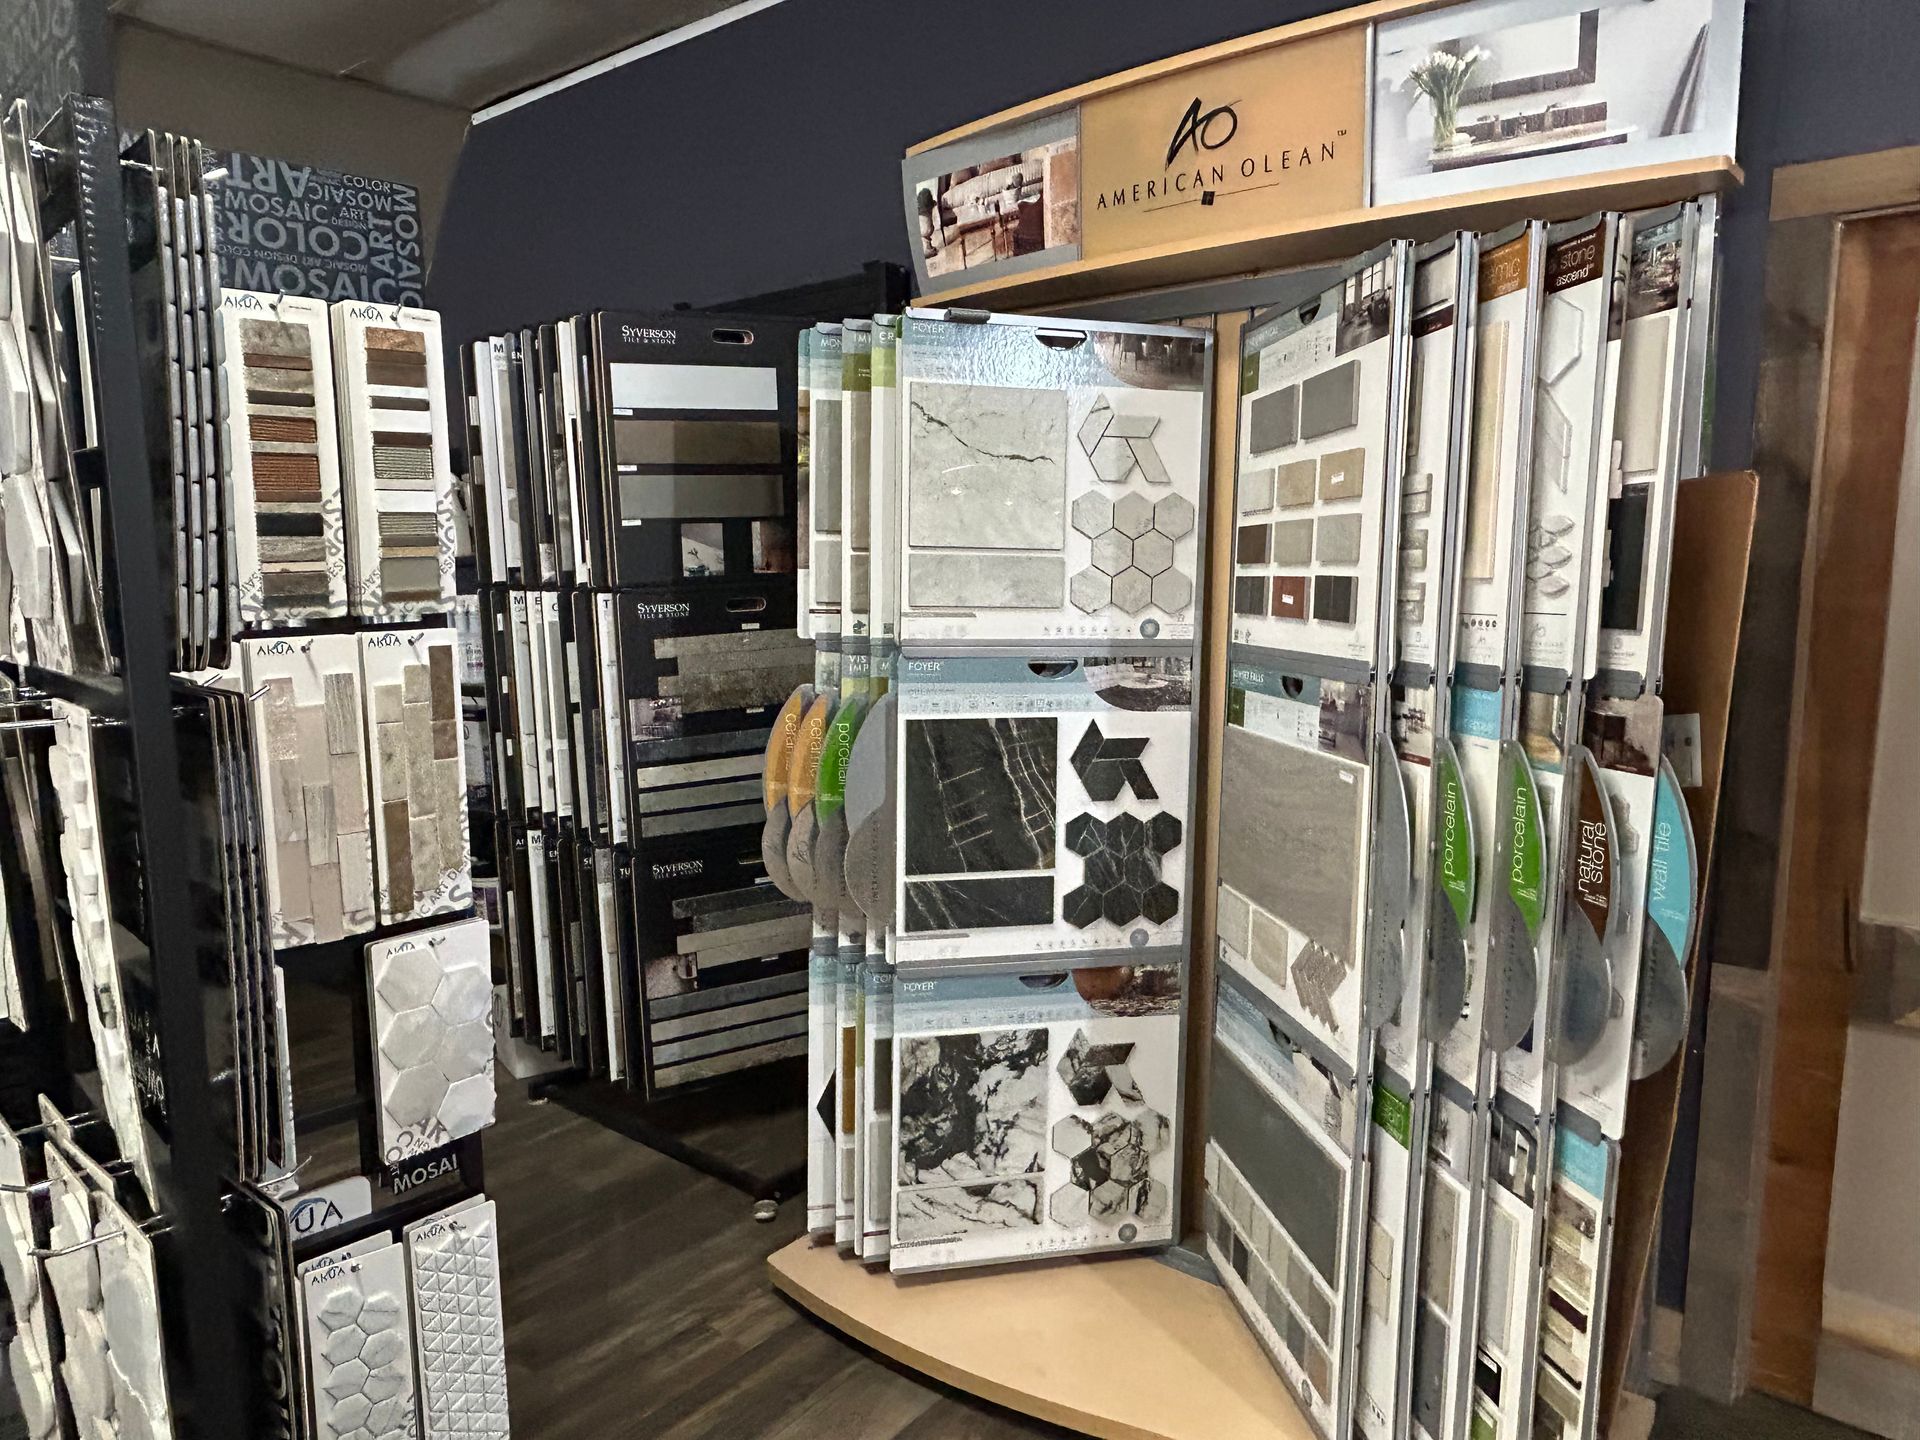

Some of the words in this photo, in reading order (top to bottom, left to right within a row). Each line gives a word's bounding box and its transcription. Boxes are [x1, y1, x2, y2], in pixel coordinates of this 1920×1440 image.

[226, 153, 311, 198] ART
[343, 174, 391, 193] COLOR
[1097, 165, 1224, 210] AMERICAN
[225, 188, 329, 224] MOSAIC
[340, 207, 364, 219] ART
[225, 211, 368, 261] COLOR
[367, 211, 395, 276] ART
[233, 258, 396, 304] MOSAIC
[224, 294, 263, 310] AKUA
[350, 304, 384, 321] AKUA
[622, 325, 676, 339] SYVERSON
[912, 322, 945, 333] FOYER
[637, 603, 690, 614] SYVERSON
[257, 641, 294, 655] AKUA
[368, 633, 402, 648] AKUA
[908, 661, 940, 671] FOYER
[836, 722, 850, 792] porcelain
[1443, 782, 1456, 876] porcelain
[1511, 787, 1527, 884] porcelain
[1655, 821, 1672, 852] tile
[1577, 820, 1595, 893] natural
[1590, 822, 1607, 883] stone
[652, 860, 703, 874] SYVERSON
[1652, 858, 1668, 901] wall
[903, 982, 935, 992] FOYER
[415, 1224, 446, 1243] AKUA
[311, 1266, 346, 1286] AKUA
